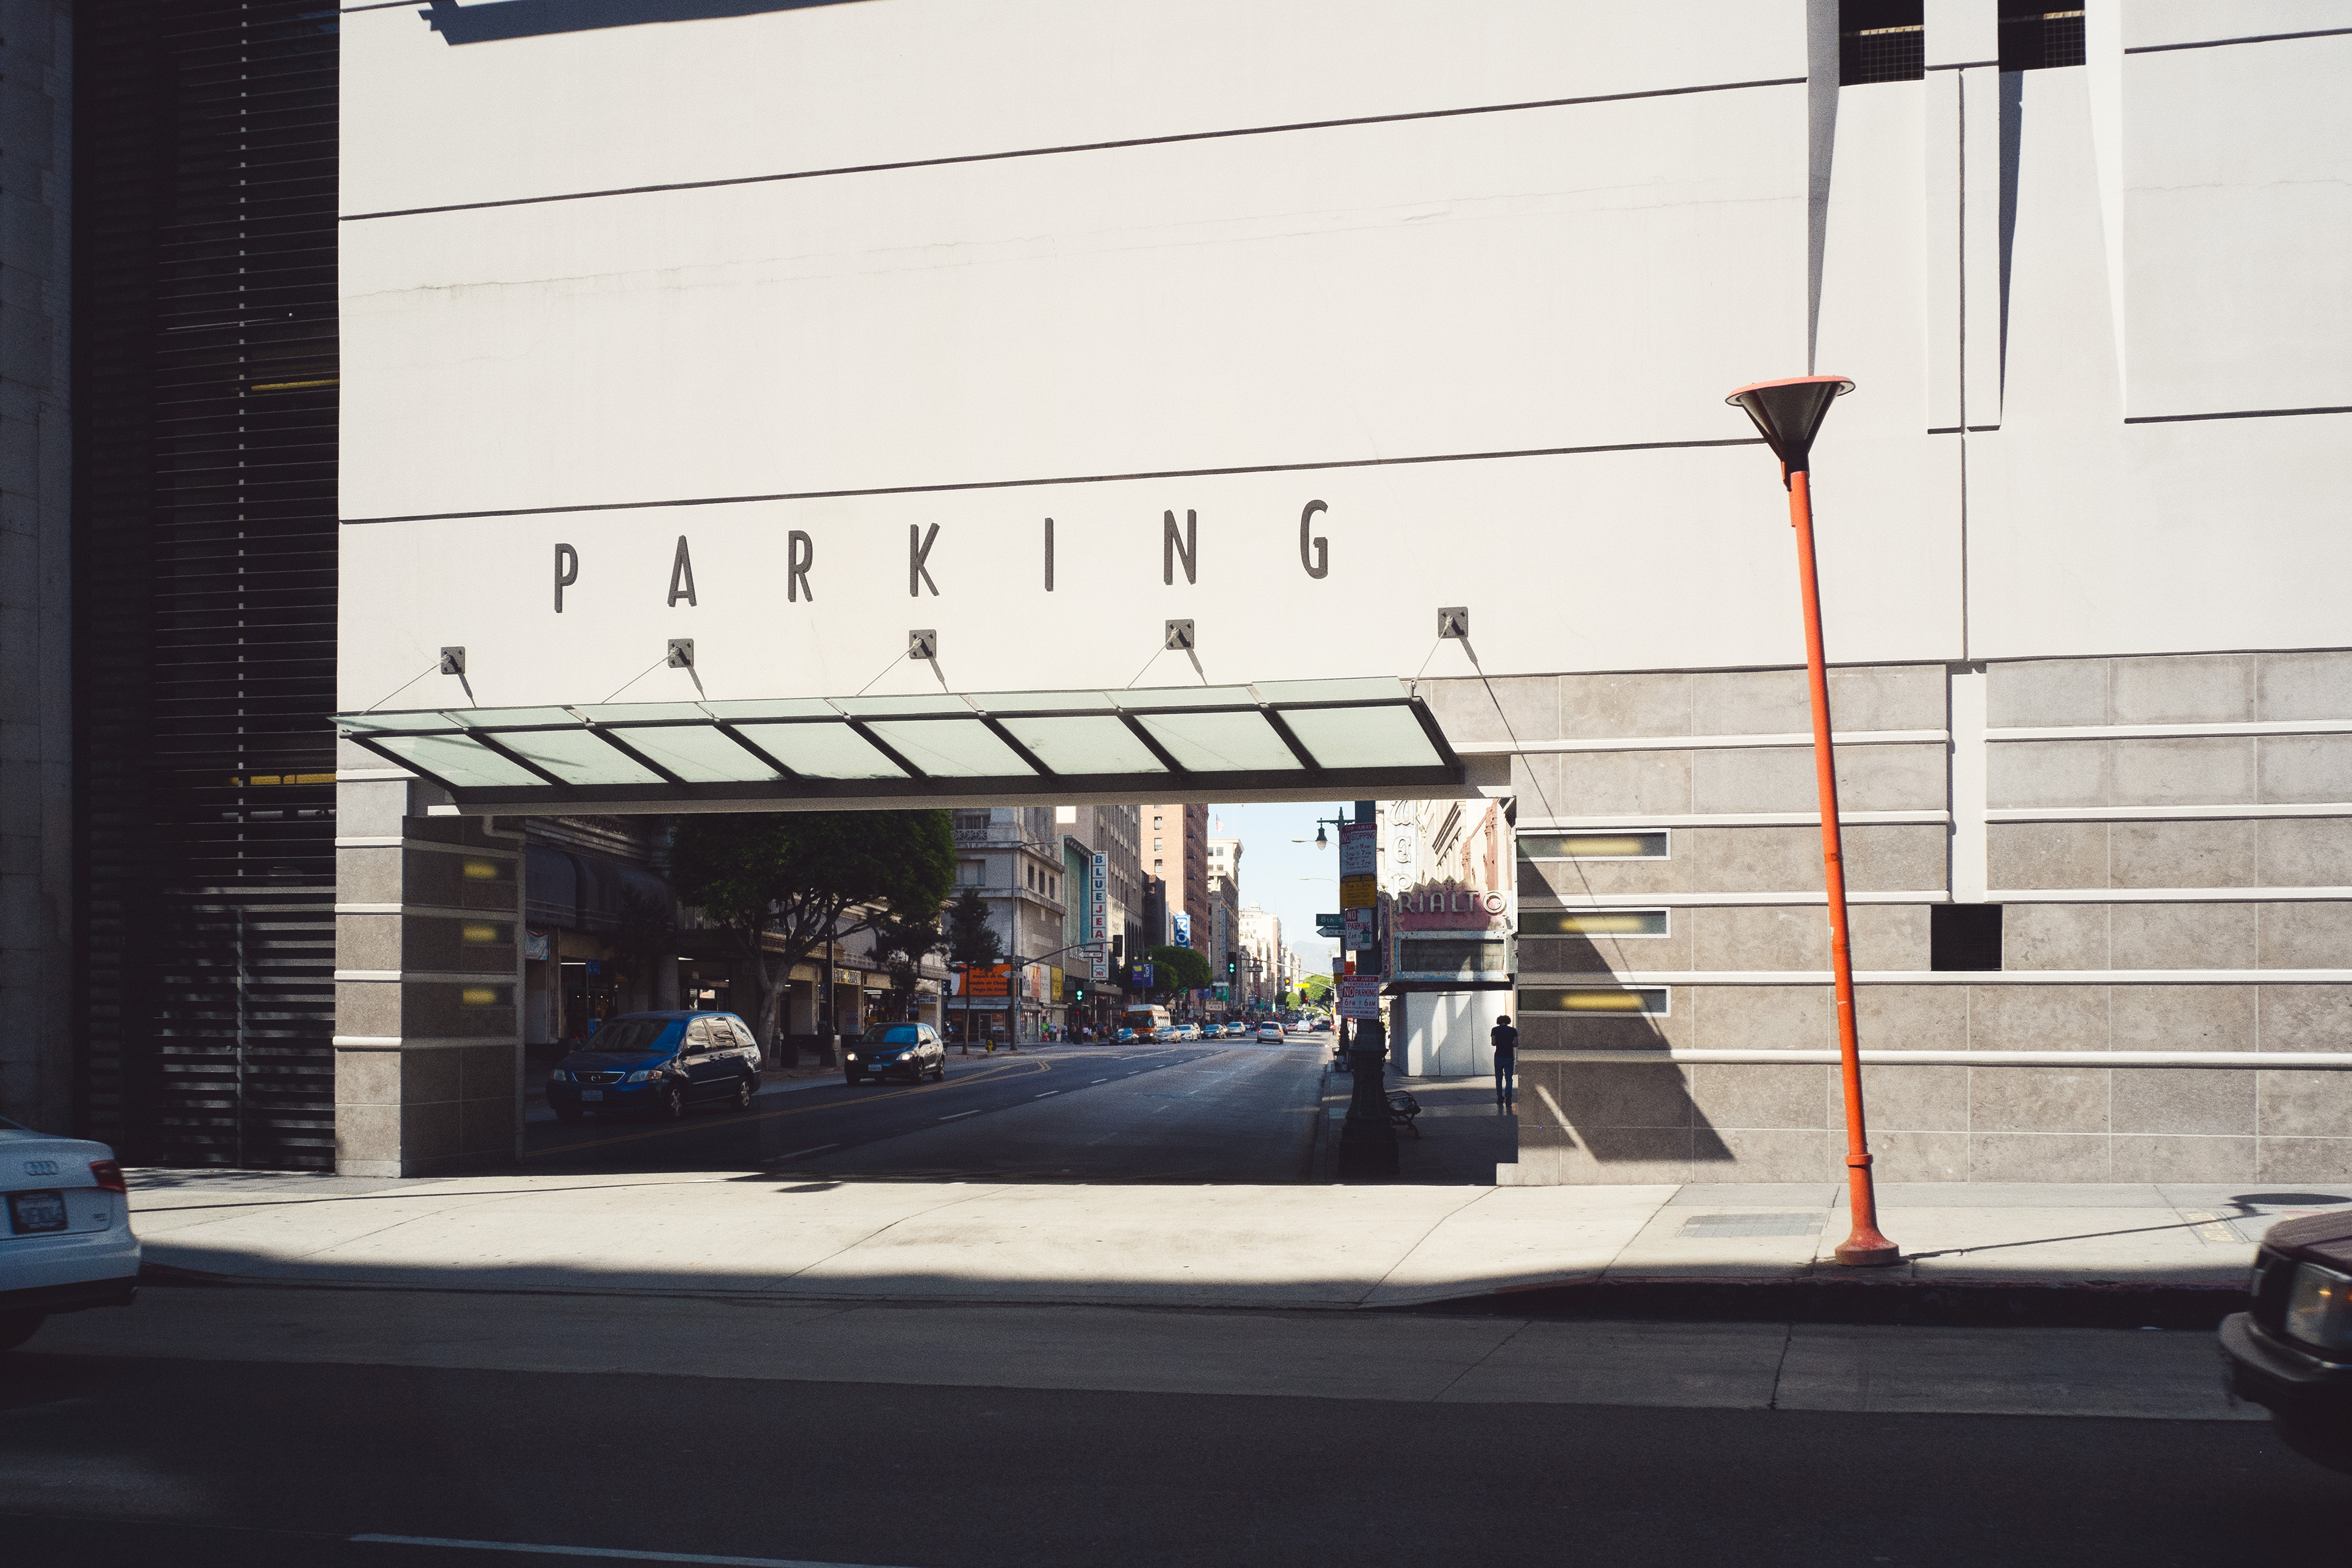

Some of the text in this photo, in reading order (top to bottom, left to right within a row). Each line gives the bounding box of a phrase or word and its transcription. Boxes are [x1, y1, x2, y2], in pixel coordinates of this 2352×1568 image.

[554, 500, 1328, 614] PARKING
[1342, 831, 1375, 843] NO STOPPING
[1095, 855, 1103, 901] BLUE
[1398, 890, 1506, 915] RIALTO
[1347, 910, 1357, 920] NO
[1347, 921, 1370, 930] PARKING
[1344, 988, 1377, 997] NO PARKING
[1364, 998, 1376, 1007] 6AM
